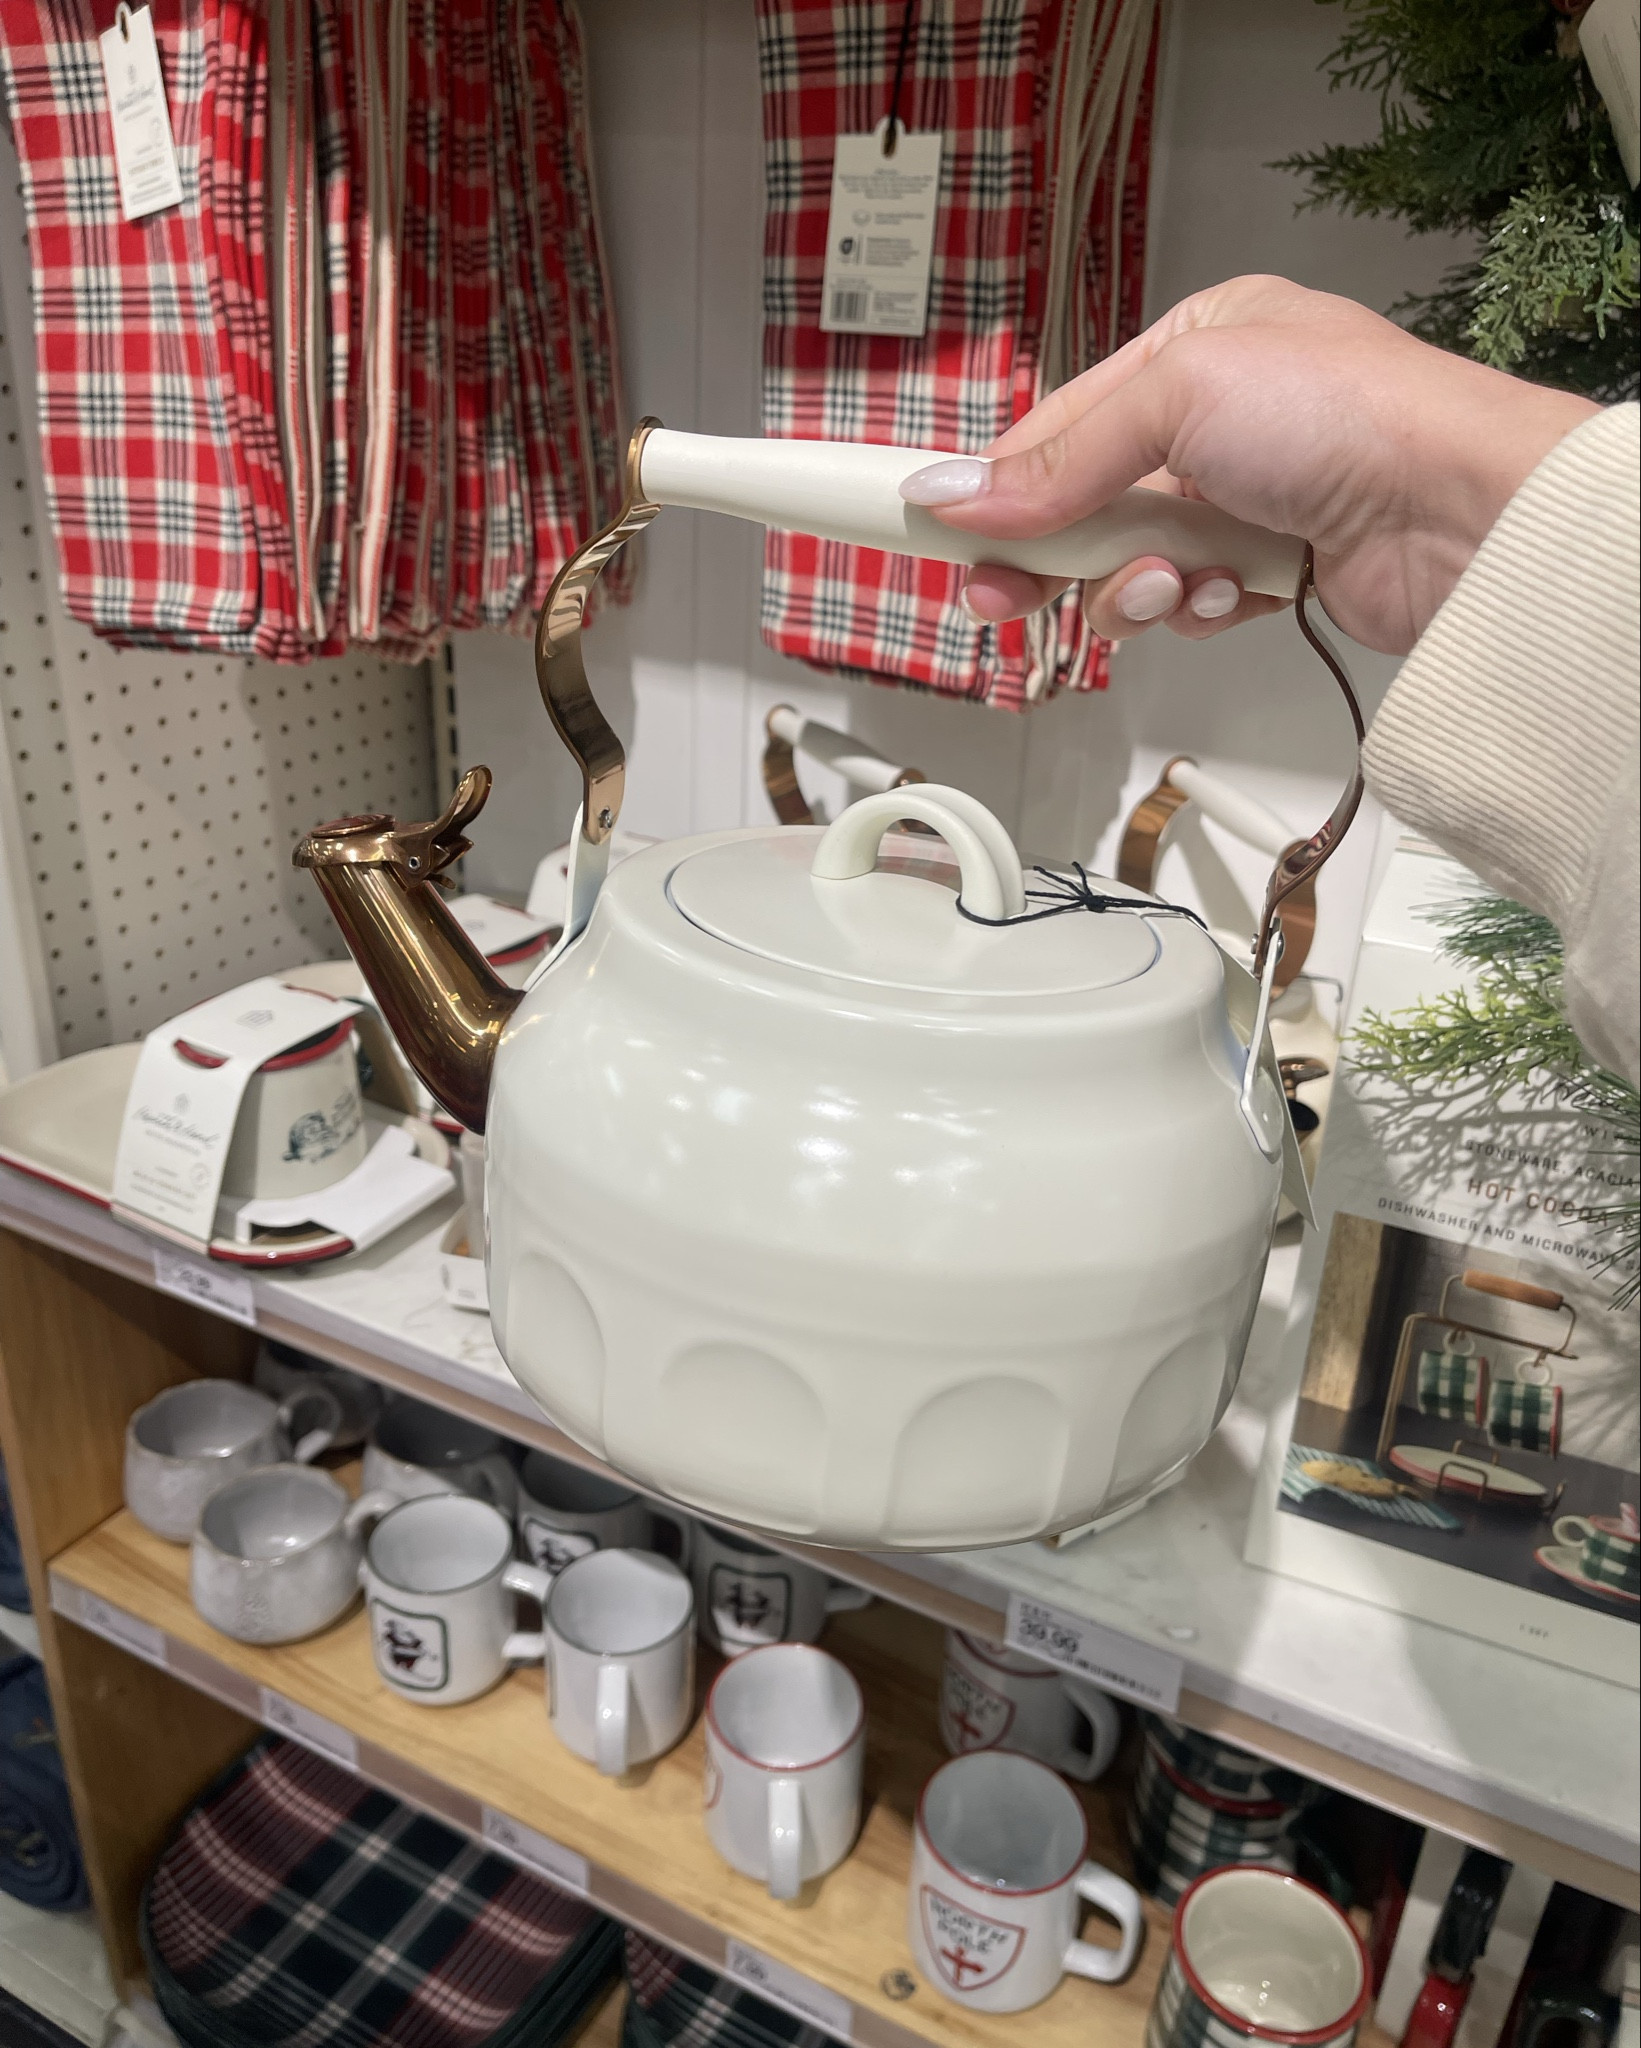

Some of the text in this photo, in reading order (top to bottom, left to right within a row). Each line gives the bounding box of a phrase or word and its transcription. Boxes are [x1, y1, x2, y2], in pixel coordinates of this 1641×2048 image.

[1467, 1177, 1516, 1203] HOT
[1378, 1197, 1477, 1233] DISHWASHER
[1484, 1224, 1516, 1241] AND
